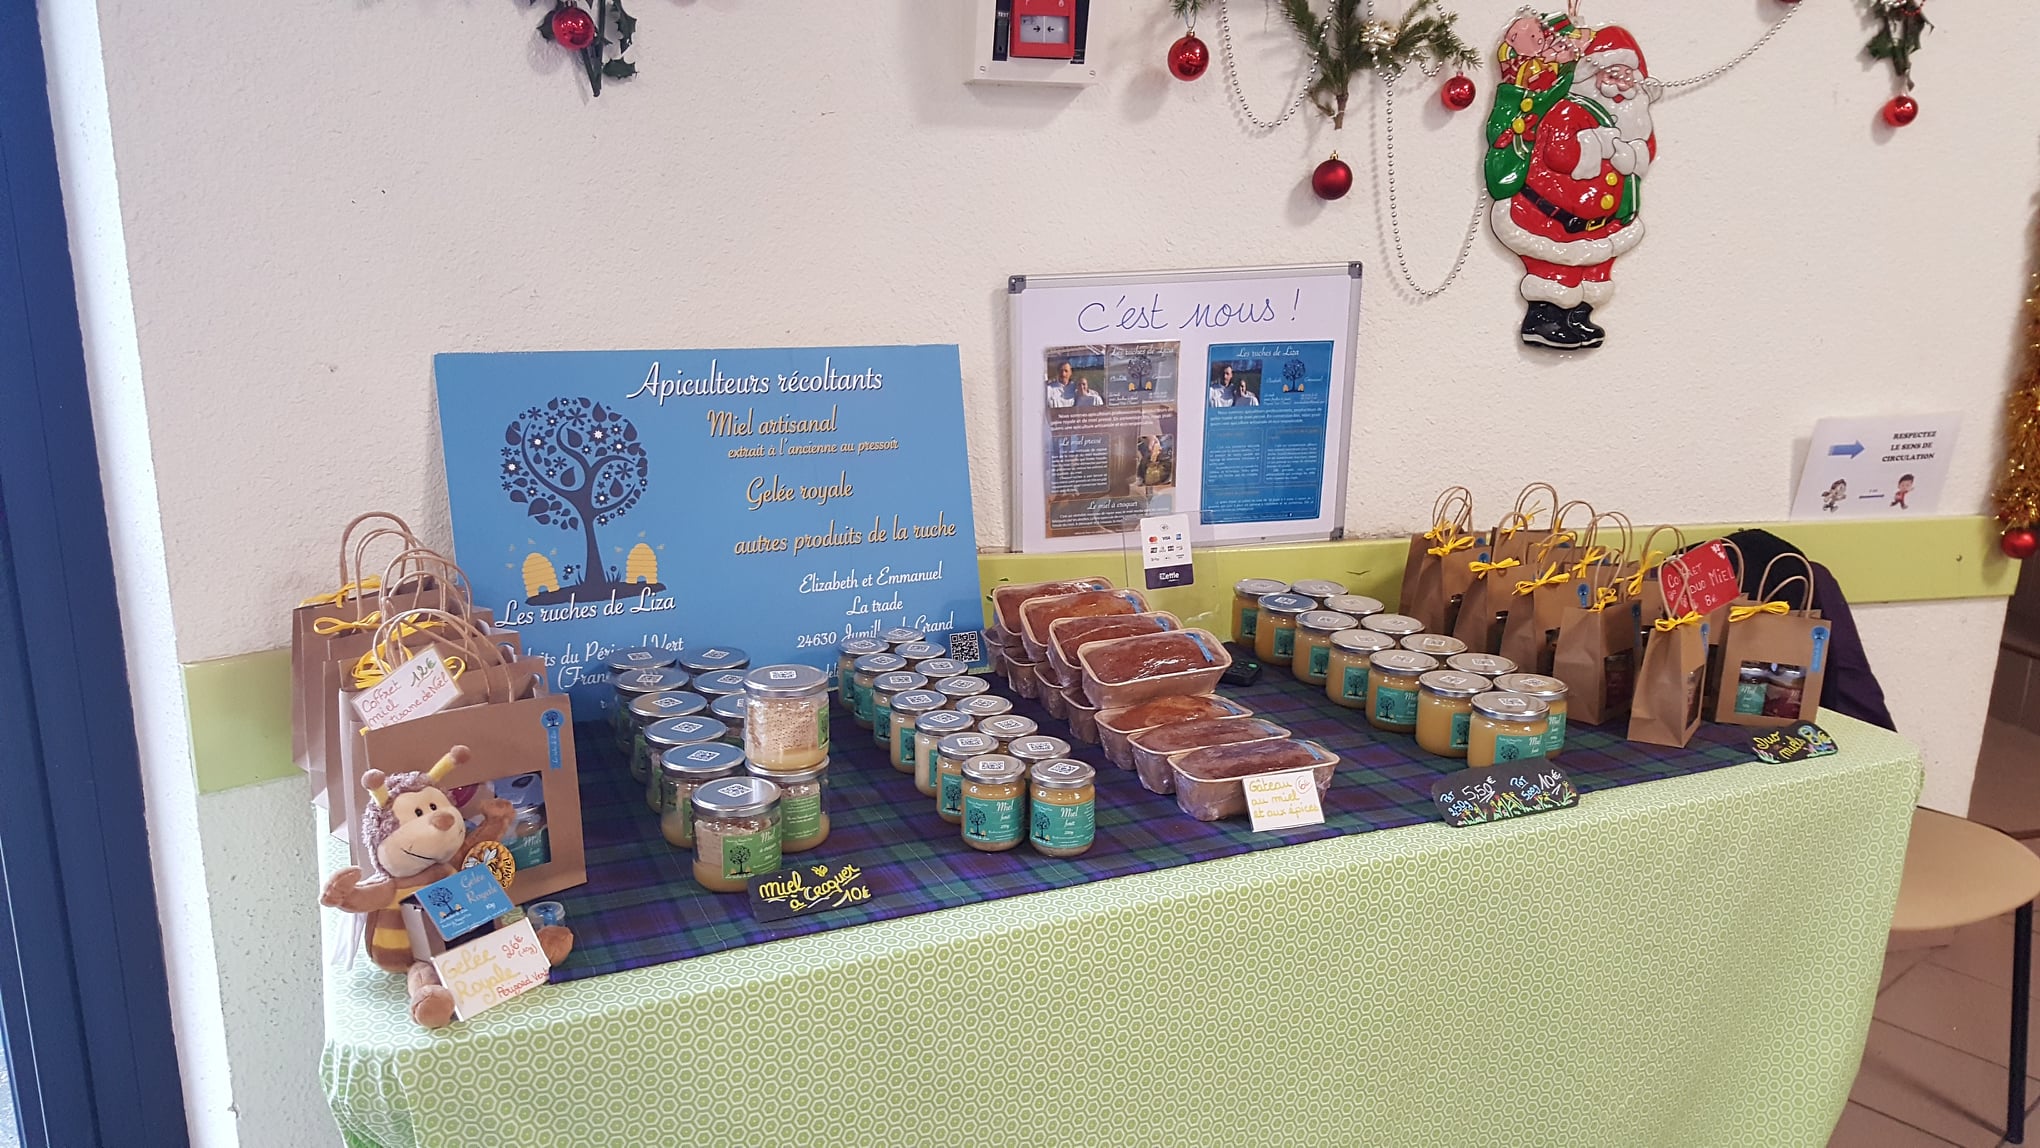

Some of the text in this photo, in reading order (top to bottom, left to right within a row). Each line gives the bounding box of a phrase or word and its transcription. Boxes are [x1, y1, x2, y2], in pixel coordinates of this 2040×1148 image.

[1077, 288, 1300, 333] C'est nous !
[1236, 348, 1250, 358] Les
[1252, 347, 1271, 357] ruches
[1273, 346, 1281, 356] de
[626, 357, 883, 405] Apiculteurs récoltants
[707, 404, 838, 437] Miel artisanal
[728, 436, 899, 458] extrait à l'ancienne au pressoir
[1890, 441, 1933, 451] LE SENS DE
[1893, 430, 1937, 440] RESPECTEZ
[1881, 452, 1935, 462] CIRCULATION
[746, 470, 853, 510] Gelée royale
[734, 511, 956, 556] autres produits de la ruche
[799, 560, 942, 594] Elizabeth et Emmanuel
[494, 587, 676, 628] Les ruches de Liza
[846, 592, 903, 616] La trade
[797, 631, 837, 649] 24630
[915, 610, 954, 633] Grand
[560, 643, 579, 665] du
[362, 679, 401, 713] Coffret
[368, 699, 399, 726] miel
[390, 699, 421, 723] tisane
[996, 799, 1014, 812] Miel
[1252, 789, 1300, 806] au miel
[1060, 805, 1079, 818] Miel
[441, 945, 496, 979] Gelée
[454, 963, 520, 1006] Royale
